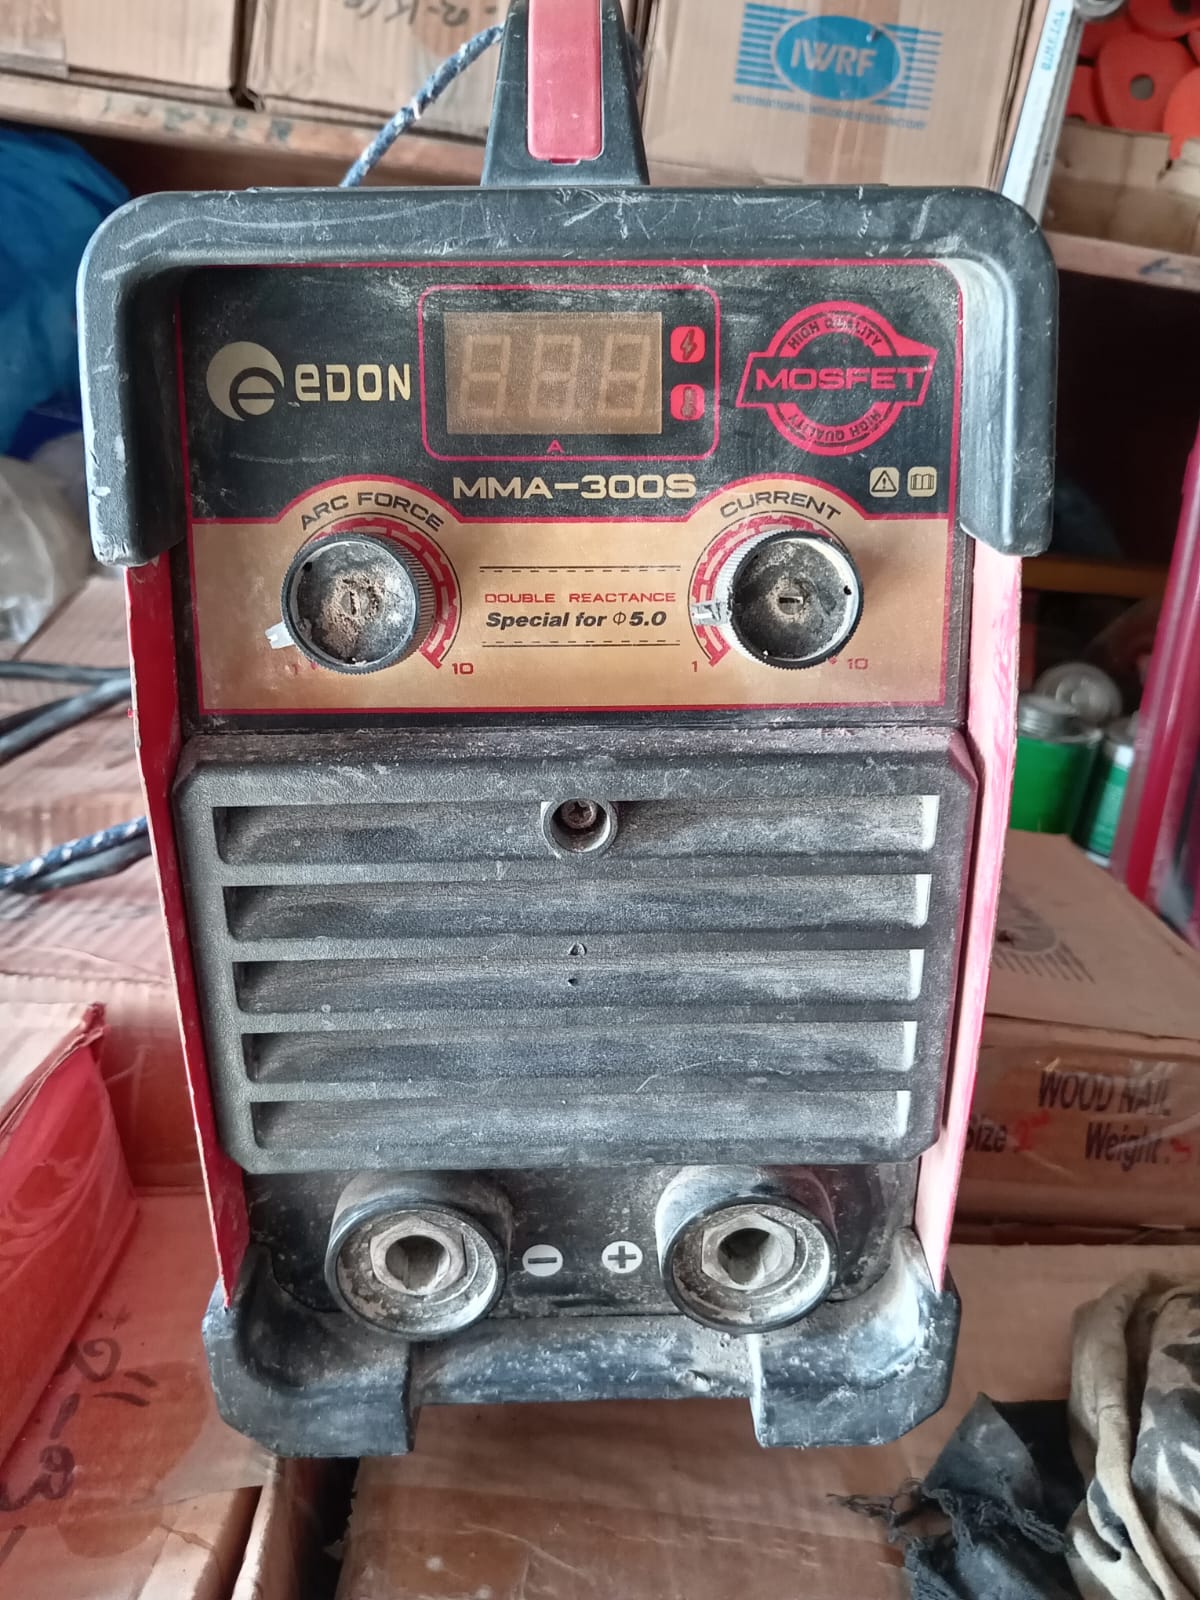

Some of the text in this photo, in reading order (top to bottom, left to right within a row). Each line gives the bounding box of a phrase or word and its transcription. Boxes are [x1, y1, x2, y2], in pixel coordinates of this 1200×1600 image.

[789, 38, 878, 78] IWRF
[787, 315, 882, 351] HIGH QUALITY
[755, 366, 926, 391] MOSFET
[787, 409, 883, 442] HIGH QUALITY
[546, 440, 564, 453] A
[453, 473, 697, 500] MMA-300S
[300, 491, 444, 533] ARC FORCE
[719, 490, 842, 521] CURRENT
[484, 592, 677, 604] DOUBLE REACTANCE
[485, 612, 570, 631] Special
[574, 611, 608, 628] for
[451, 662, 474, 676] 10
[691, 660, 698, 673] 1
[847, 657, 869, 671] 10
[1038, 1070, 1115, 1112] WOOD
